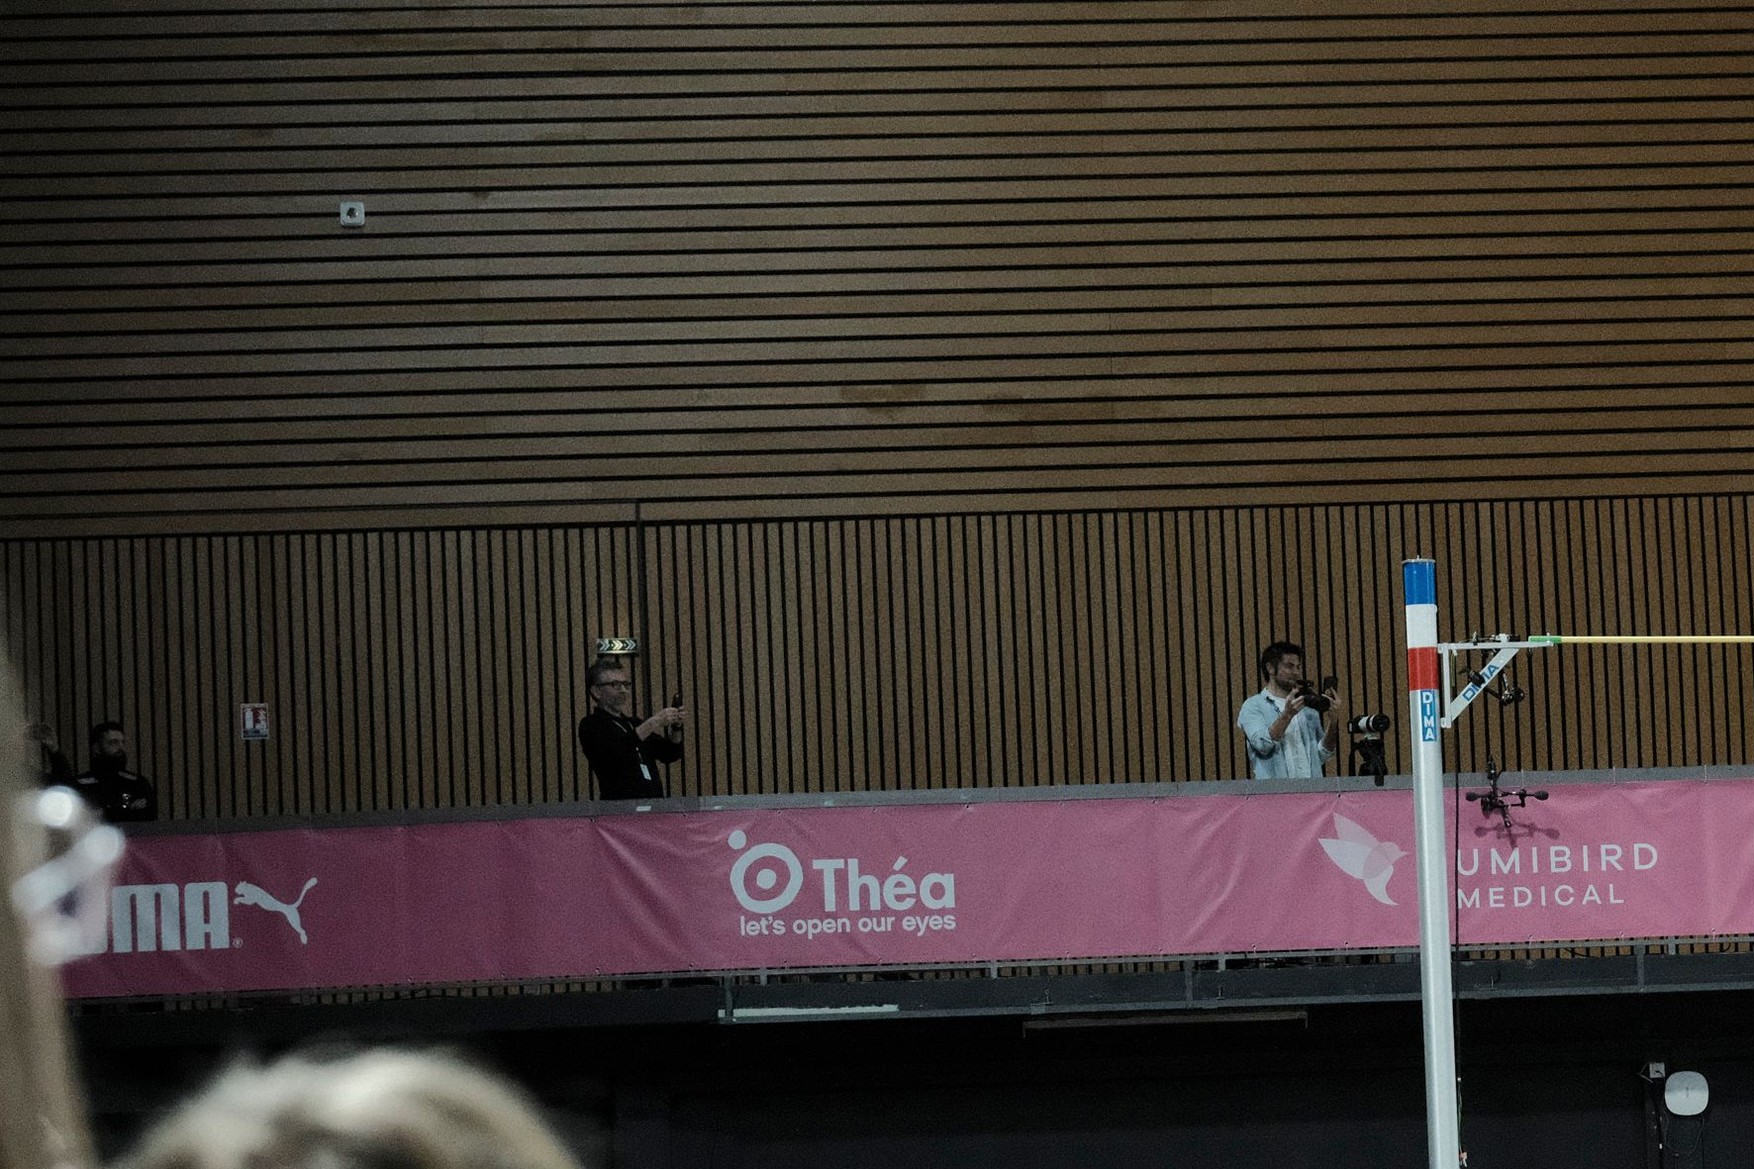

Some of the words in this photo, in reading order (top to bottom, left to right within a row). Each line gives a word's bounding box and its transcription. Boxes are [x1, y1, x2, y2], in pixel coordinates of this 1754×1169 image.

[1422, 691, 1435, 740] DIMA
[1456, 843, 1659, 876] UMIBIRD
[812, 856, 956, 911] Théa
[1457, 883, 1625, 910] MEDICAL
[82, 875, 231, 955] MA
[740, 914, 786, 936] let's
[792, 915, 851, 939] open
[857, 913, 895, 933] our
[902, 912, 957, 938] eyes
